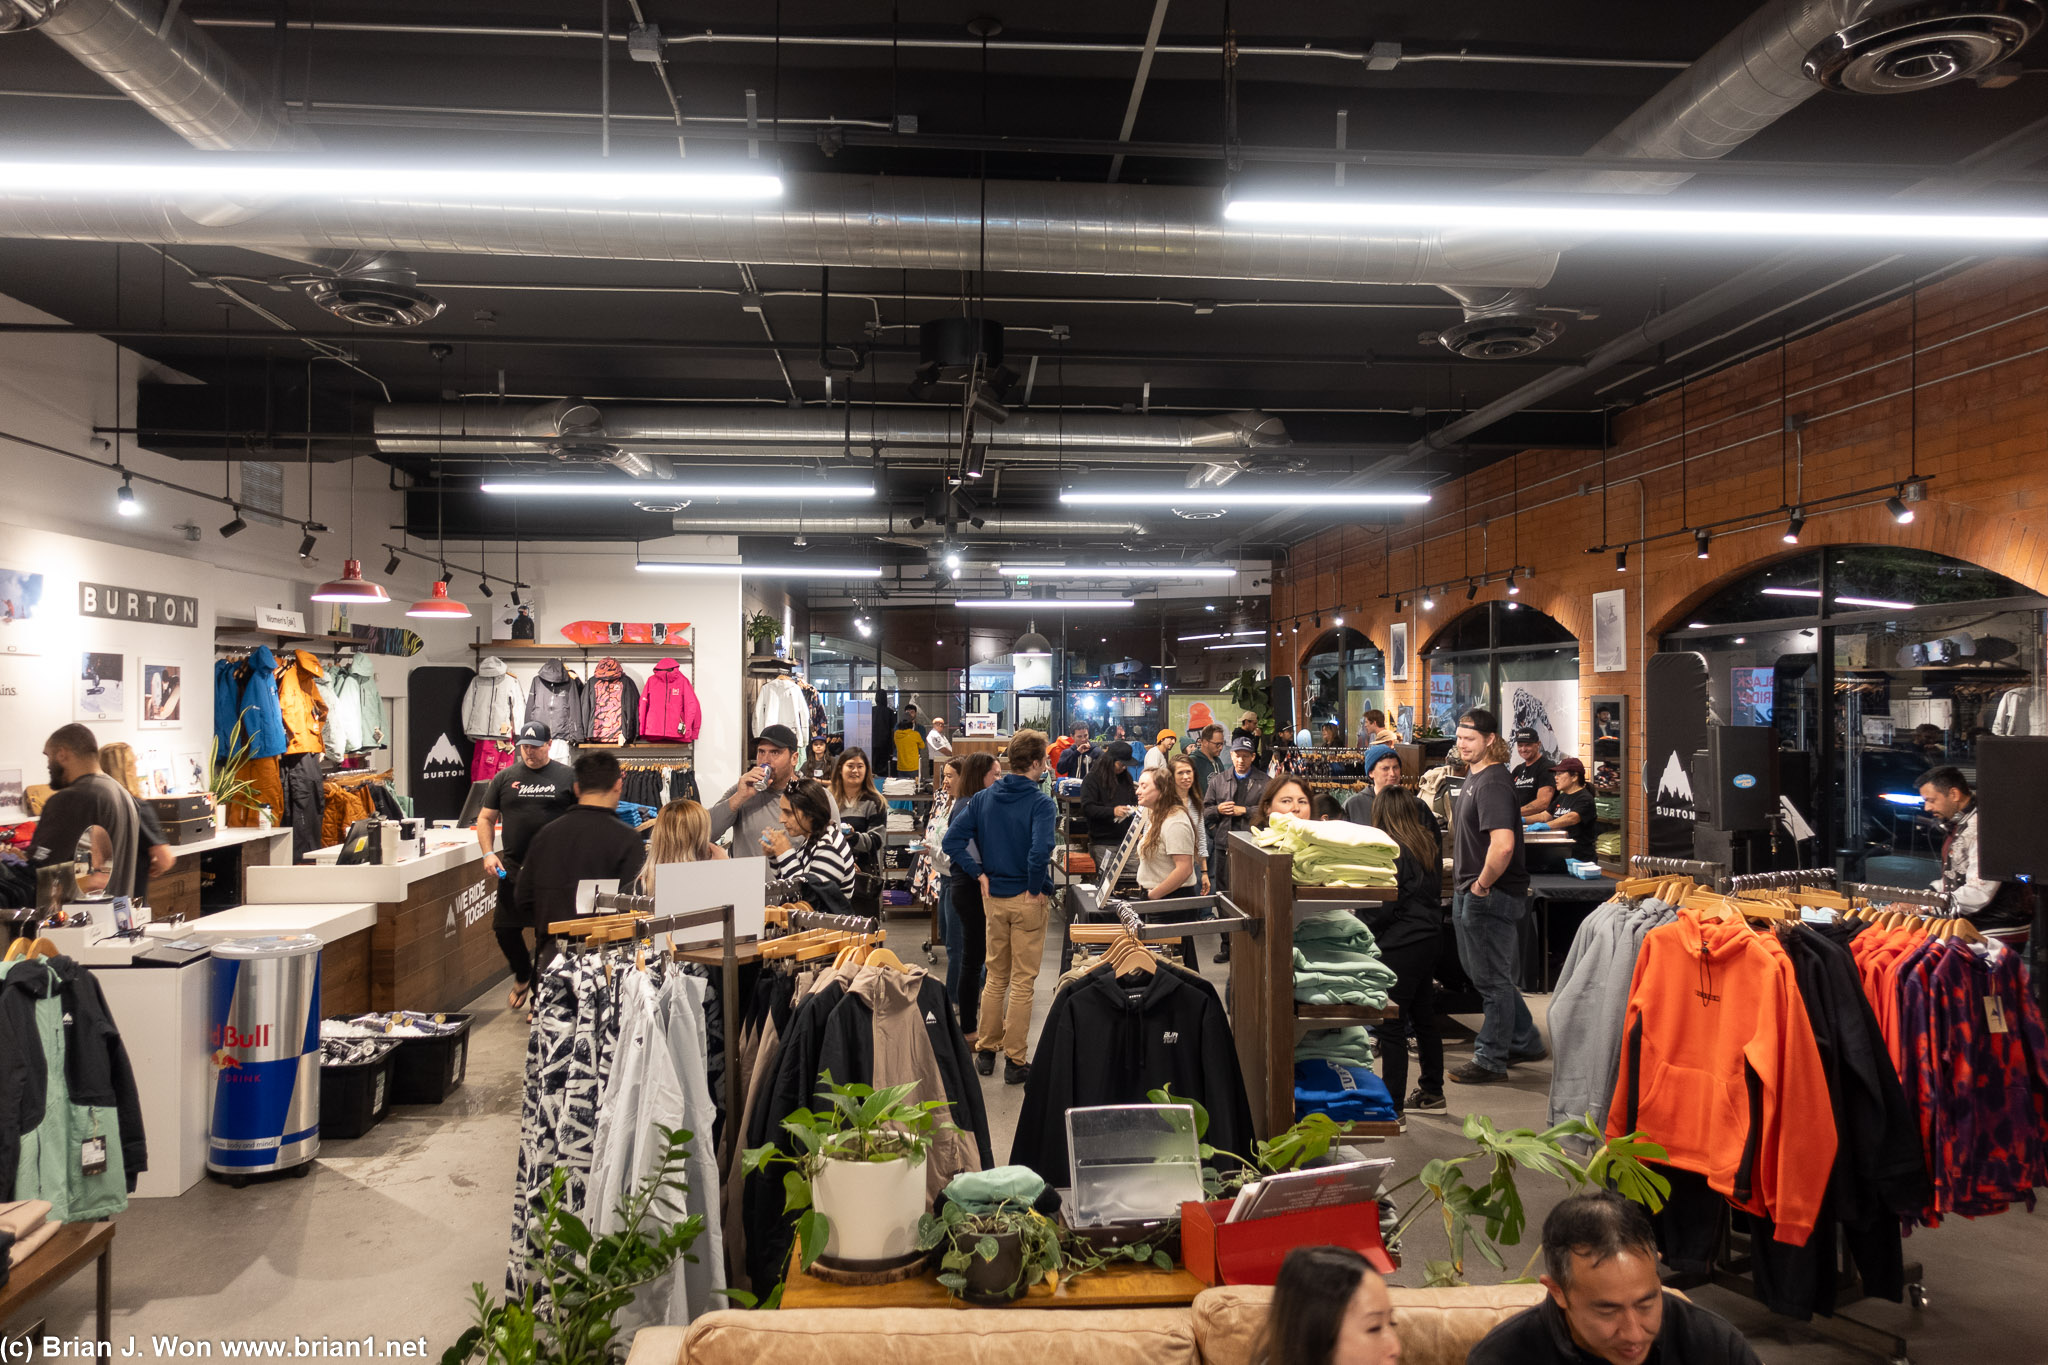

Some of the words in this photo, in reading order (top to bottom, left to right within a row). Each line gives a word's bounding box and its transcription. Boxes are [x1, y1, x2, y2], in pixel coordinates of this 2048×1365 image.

[84, 586, 195, 623] BURTON
[423, 769, 465, 779] BURTON
[518, 784, 556, 795] Wahoo's
[1656, 806, 1696, 820] BURTON
[456, 891, 468, 914] WE
[469, 879, 486, 906] RIDE
[465, 890, 498, 928] TOGETHE
[224, 1024, 269, 1048] Bull
[256, 1139, 274, 1147] mind
